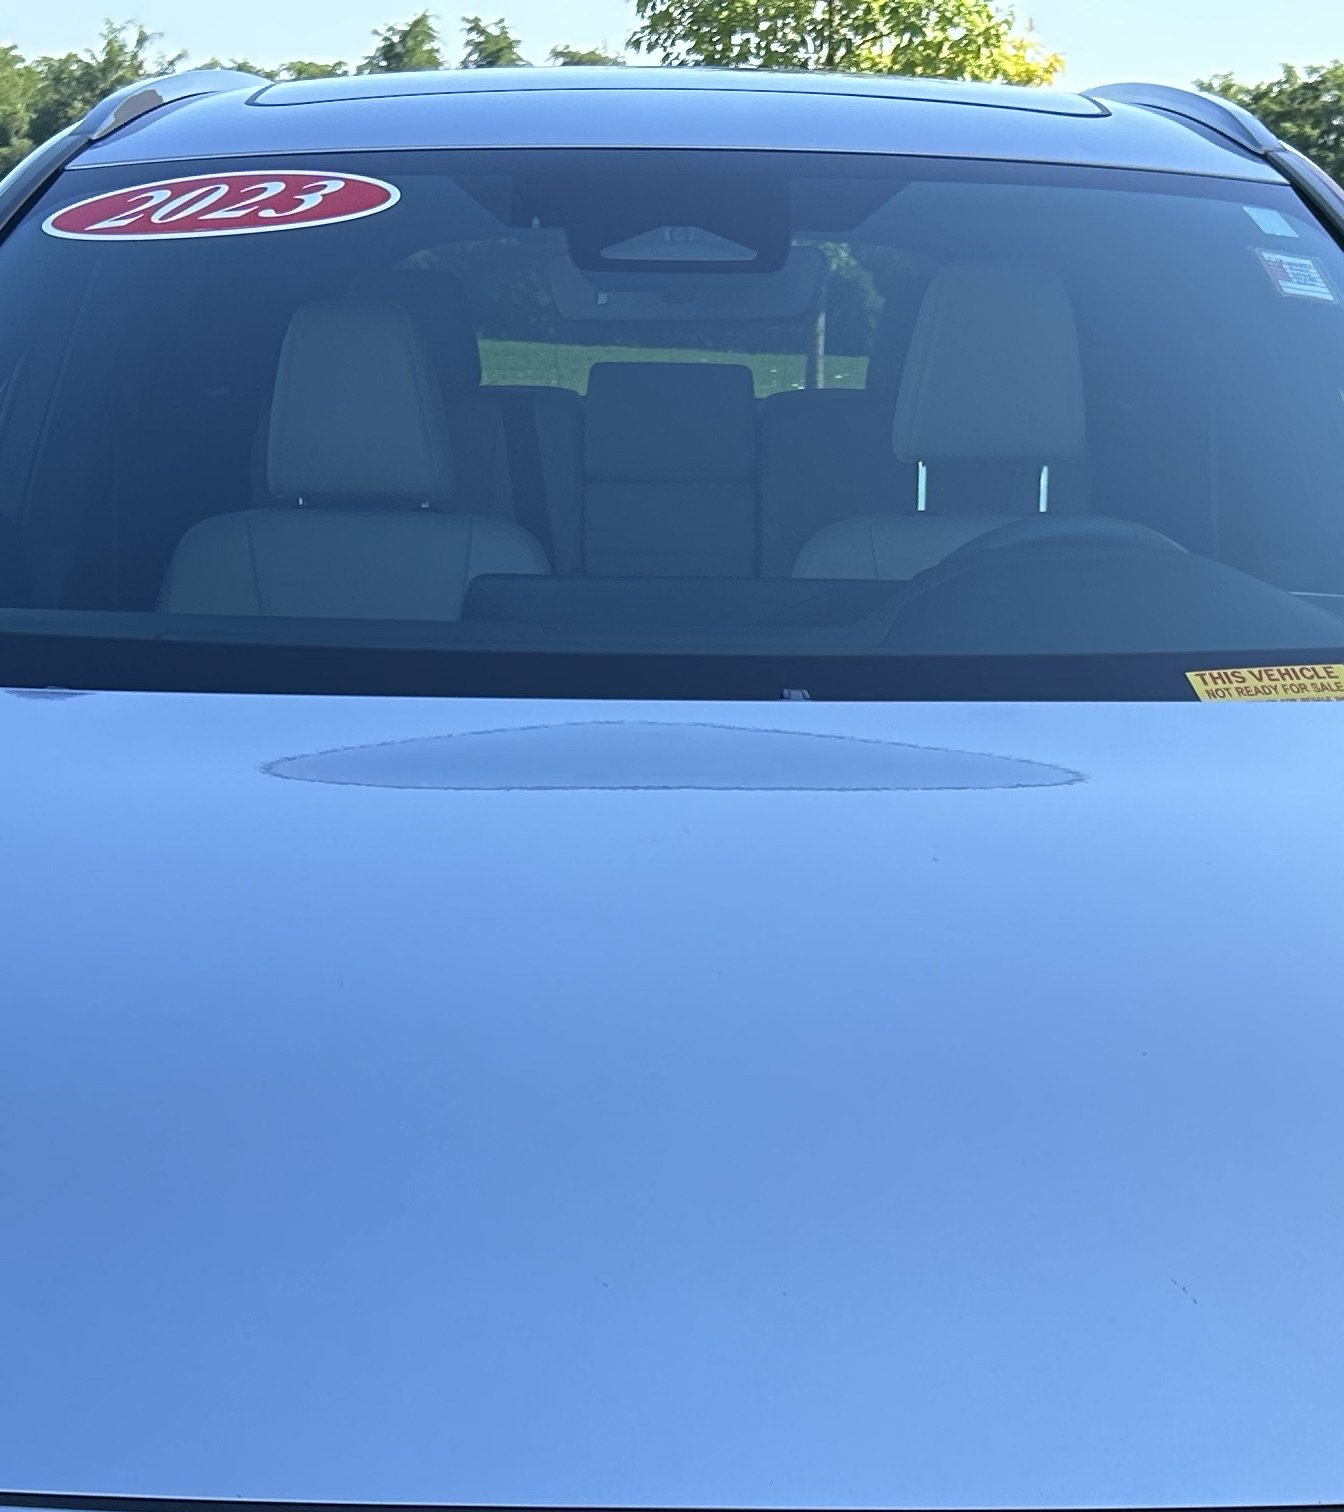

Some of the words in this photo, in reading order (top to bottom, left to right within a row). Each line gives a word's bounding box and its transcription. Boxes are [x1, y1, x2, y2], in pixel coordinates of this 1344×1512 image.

[84, 180, 346, 231] 2023
[1194, 671, 1247, 686] THIS
[1248, 665, 1340, 683] VEHICLE
[1205, 687, 1235, 699] NOT
[1237, 684, 1280, 697] READY
[1282, 682, 1310, 694] FOR
